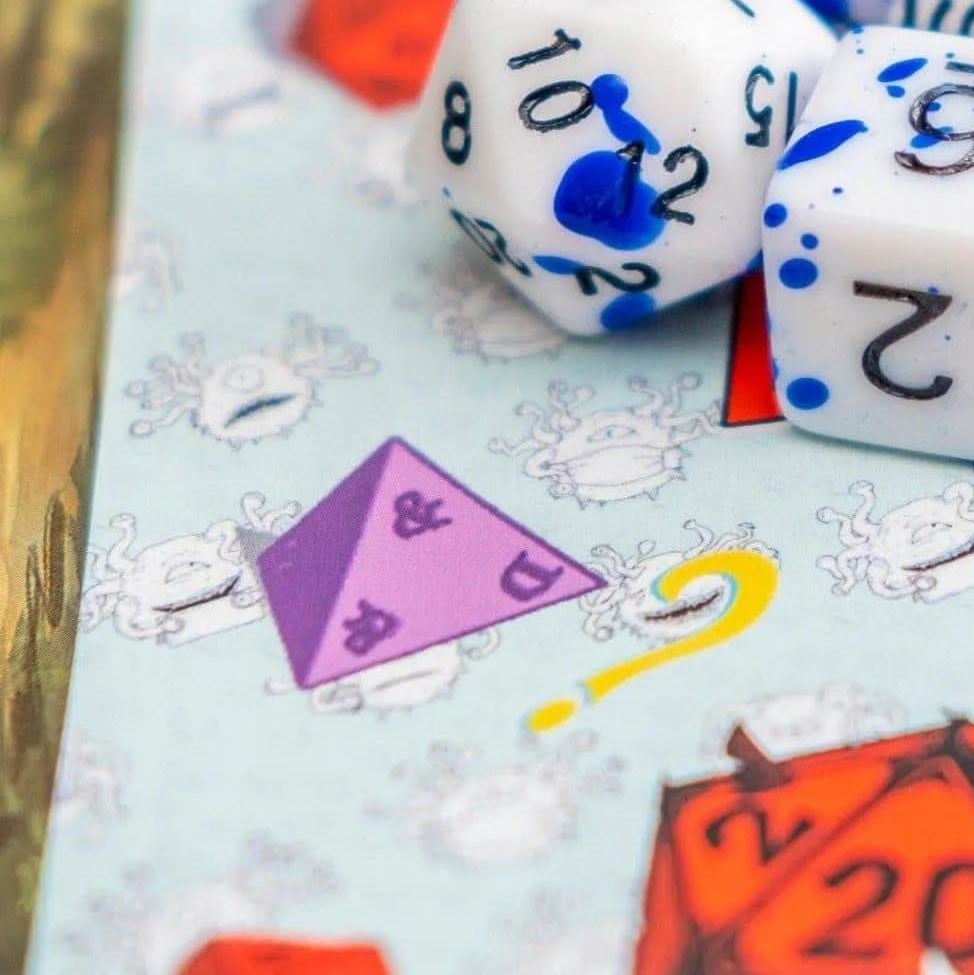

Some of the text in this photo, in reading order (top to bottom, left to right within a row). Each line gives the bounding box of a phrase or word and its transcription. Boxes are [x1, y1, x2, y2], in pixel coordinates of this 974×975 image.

[441, 80, 472, 166] 8
[572, 261, 661, 297] 2
[853, 280, 954, 402] 2
